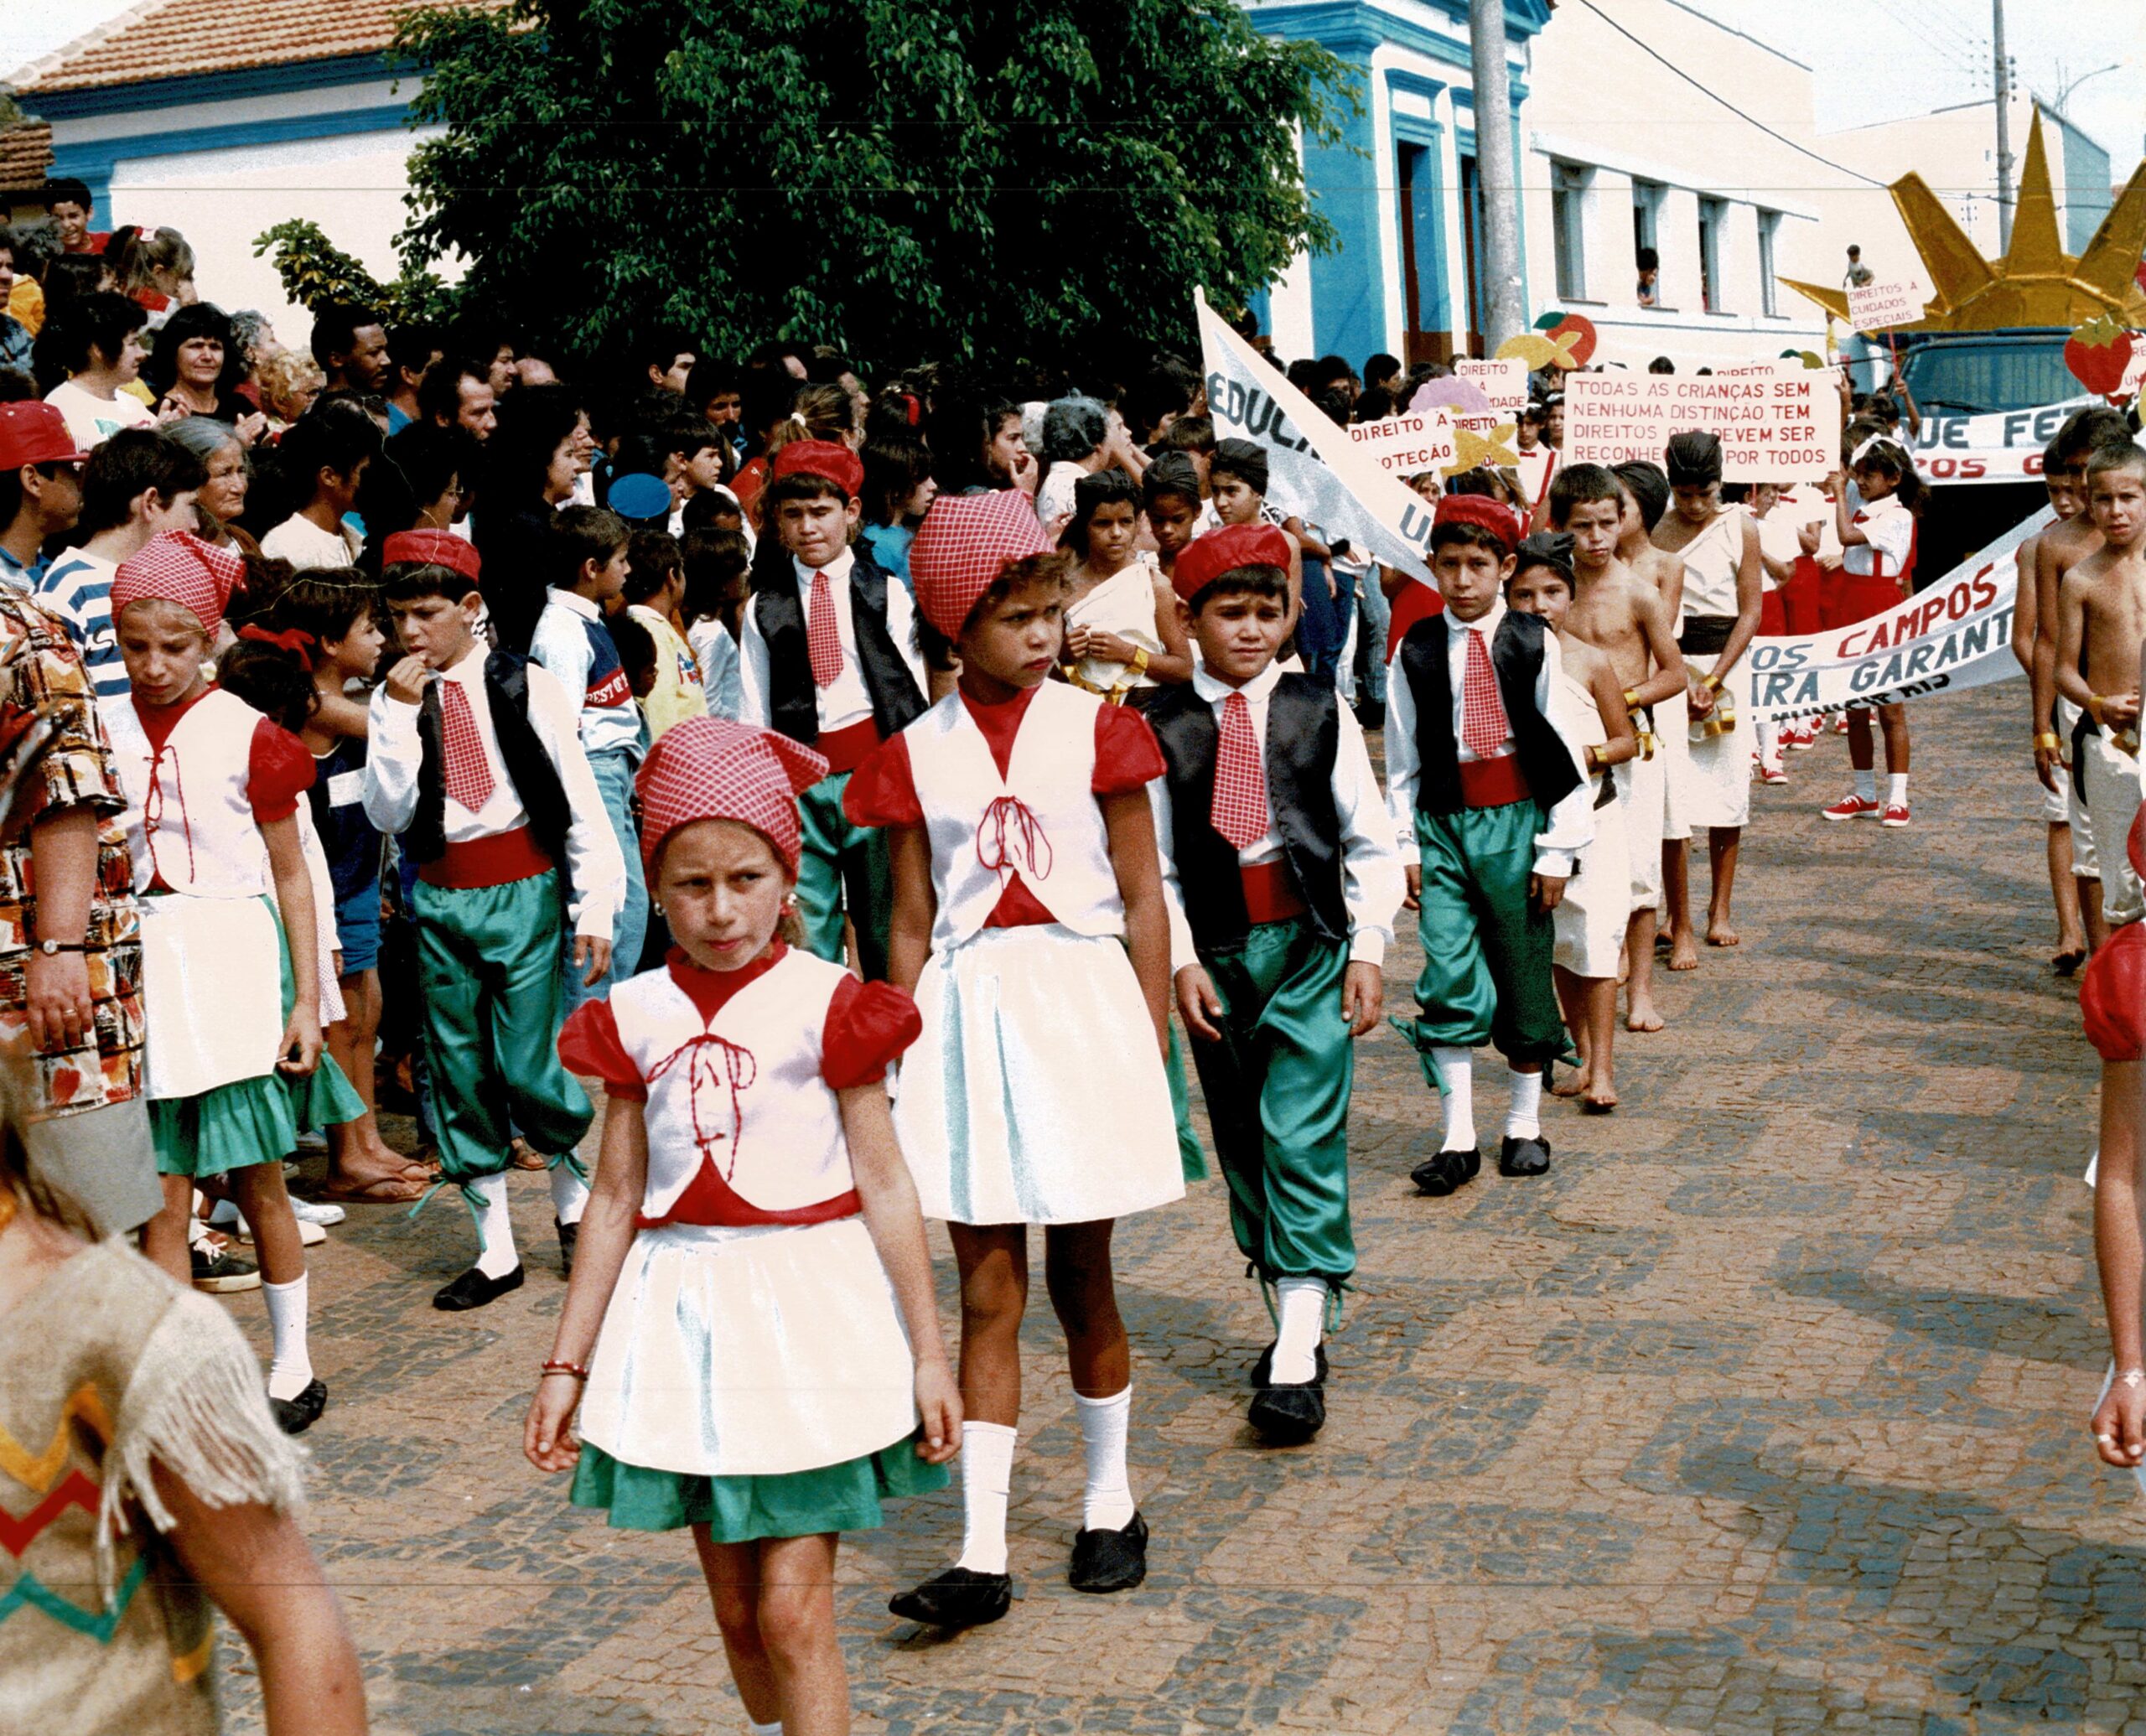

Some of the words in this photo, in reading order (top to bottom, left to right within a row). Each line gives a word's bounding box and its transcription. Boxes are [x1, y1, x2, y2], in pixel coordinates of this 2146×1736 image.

[1849, 285, 1902, 302] DIREITOS
[1910, 281, 1918, 291] A
[1851, 298, 1907, 315] CUIDADOS
[1853, 311, 1913, 329] ESPECIAIS
[1460, 365, 1508, 376] DIREITO
[1574, 381, 1638, 396] TODAS
[1647, 382, 1670, 396] AS
[1677, 383, 1764, 402] CRIANÇAS
[1774, 381, 1811, 397] SEM
[1573, 402, 1664, 417] NENHUMA
[1771, 405, 1811, 419] TEM
[1351, 417, 1423, 443] DIREITO
[1573, 424, 1657, 439] DIREITOS
[1712, 428, 1772, 443] DEVEM
[1780, 426, 1816, 441] SER
[1726, 450, 1759, 464] POR
[1838, 562, 1998, 658] CAMPOS
[1849, 605, 2014, 692] GARANT
